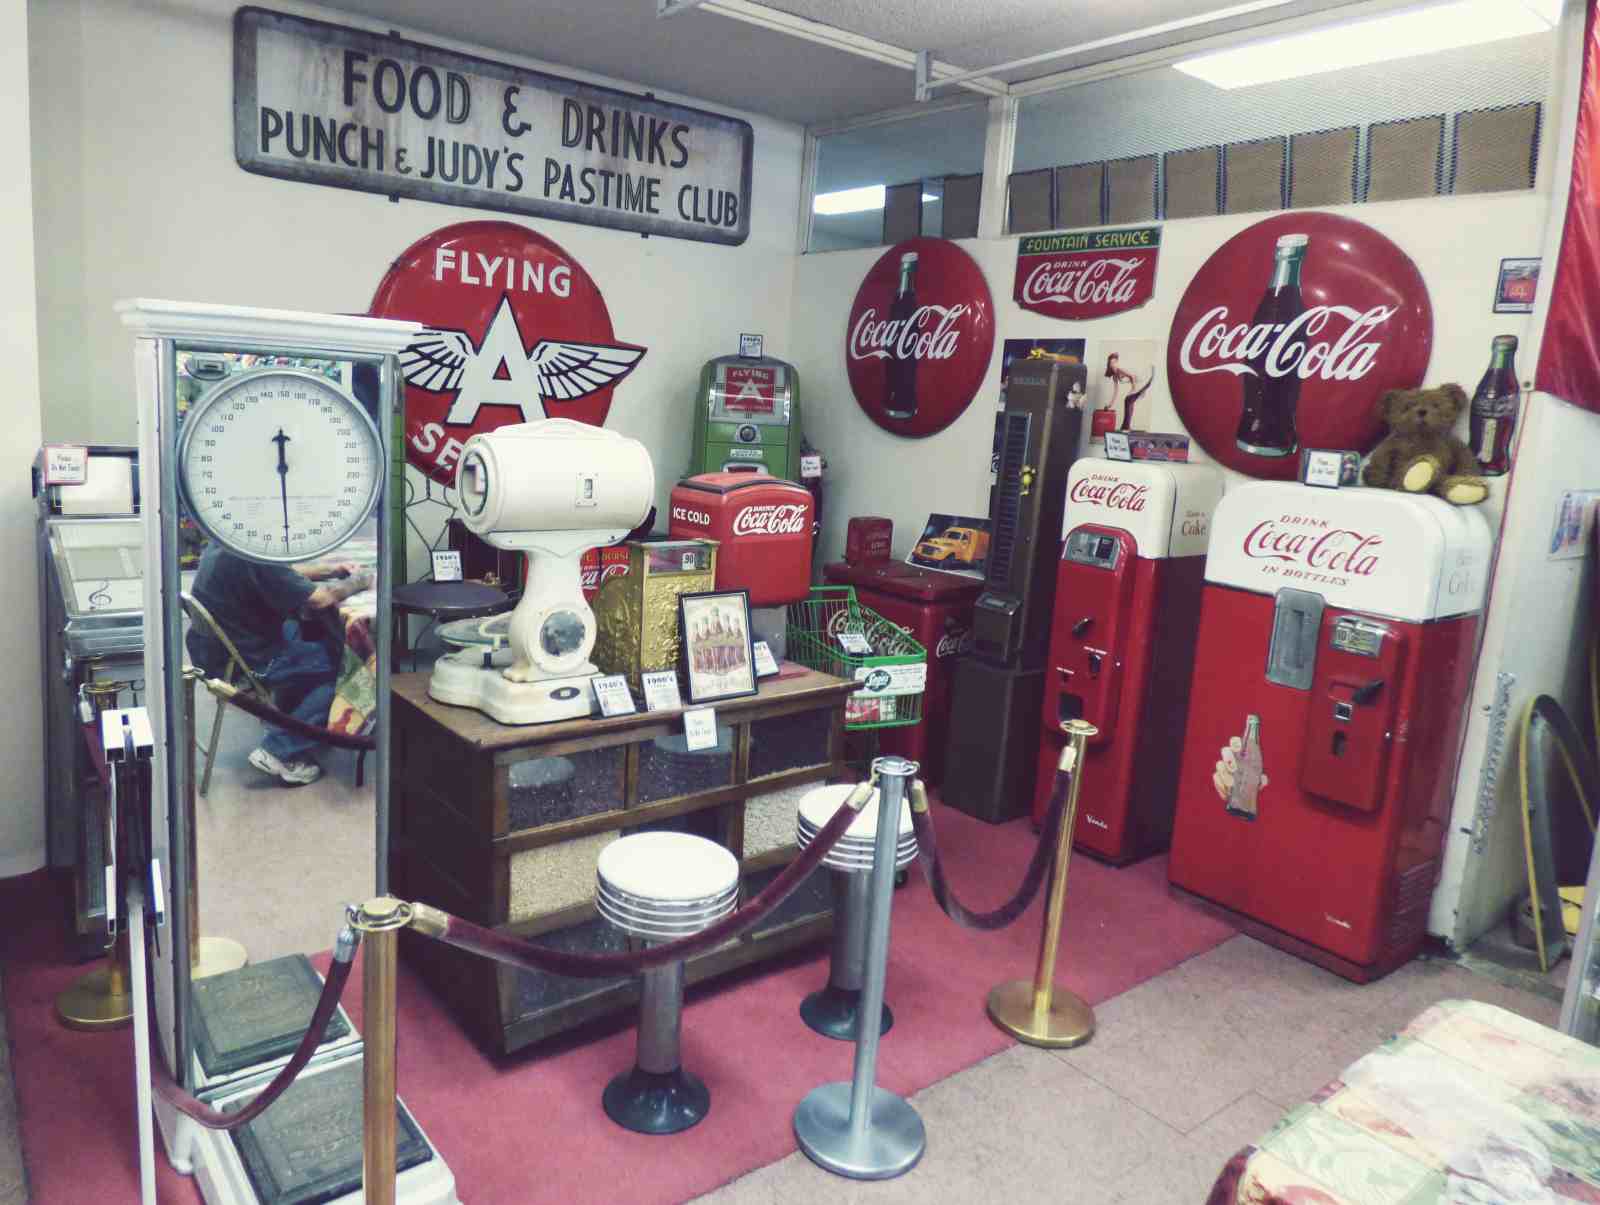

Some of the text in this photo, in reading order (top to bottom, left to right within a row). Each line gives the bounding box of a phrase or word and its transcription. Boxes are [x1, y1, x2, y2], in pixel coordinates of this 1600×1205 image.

[342, 48, 691, 169] FOOD & DRINKS
[260, 106, 384, 172] PUNCH
[419, 136, 524, 193] JUDY'S
[543, 157, 661, 214] PASTIME
[677, 184, 739, 227] CLUB
[1026, 230, 1150, 251] FOUNTAIN SERVICE
[435, 247, 572, 298] FLYING
[1023, 257, 1146, 304] Coca-Cola
[1053, 260, 1088, 269] DRINK
[850, 303, 972, 360] Coca-Cola
[1180, 305, 1399, 381] Coca-Cola
[673, 507, 711, 526] ICE COLD
[1070, 478, 1147, 511] Coca-Cola
[733, 504, 809, 536] Coca-Cola
[1280, 515, 1329, 528] DRINK
[1244, 520, 1383, 575] Coca-Cola
